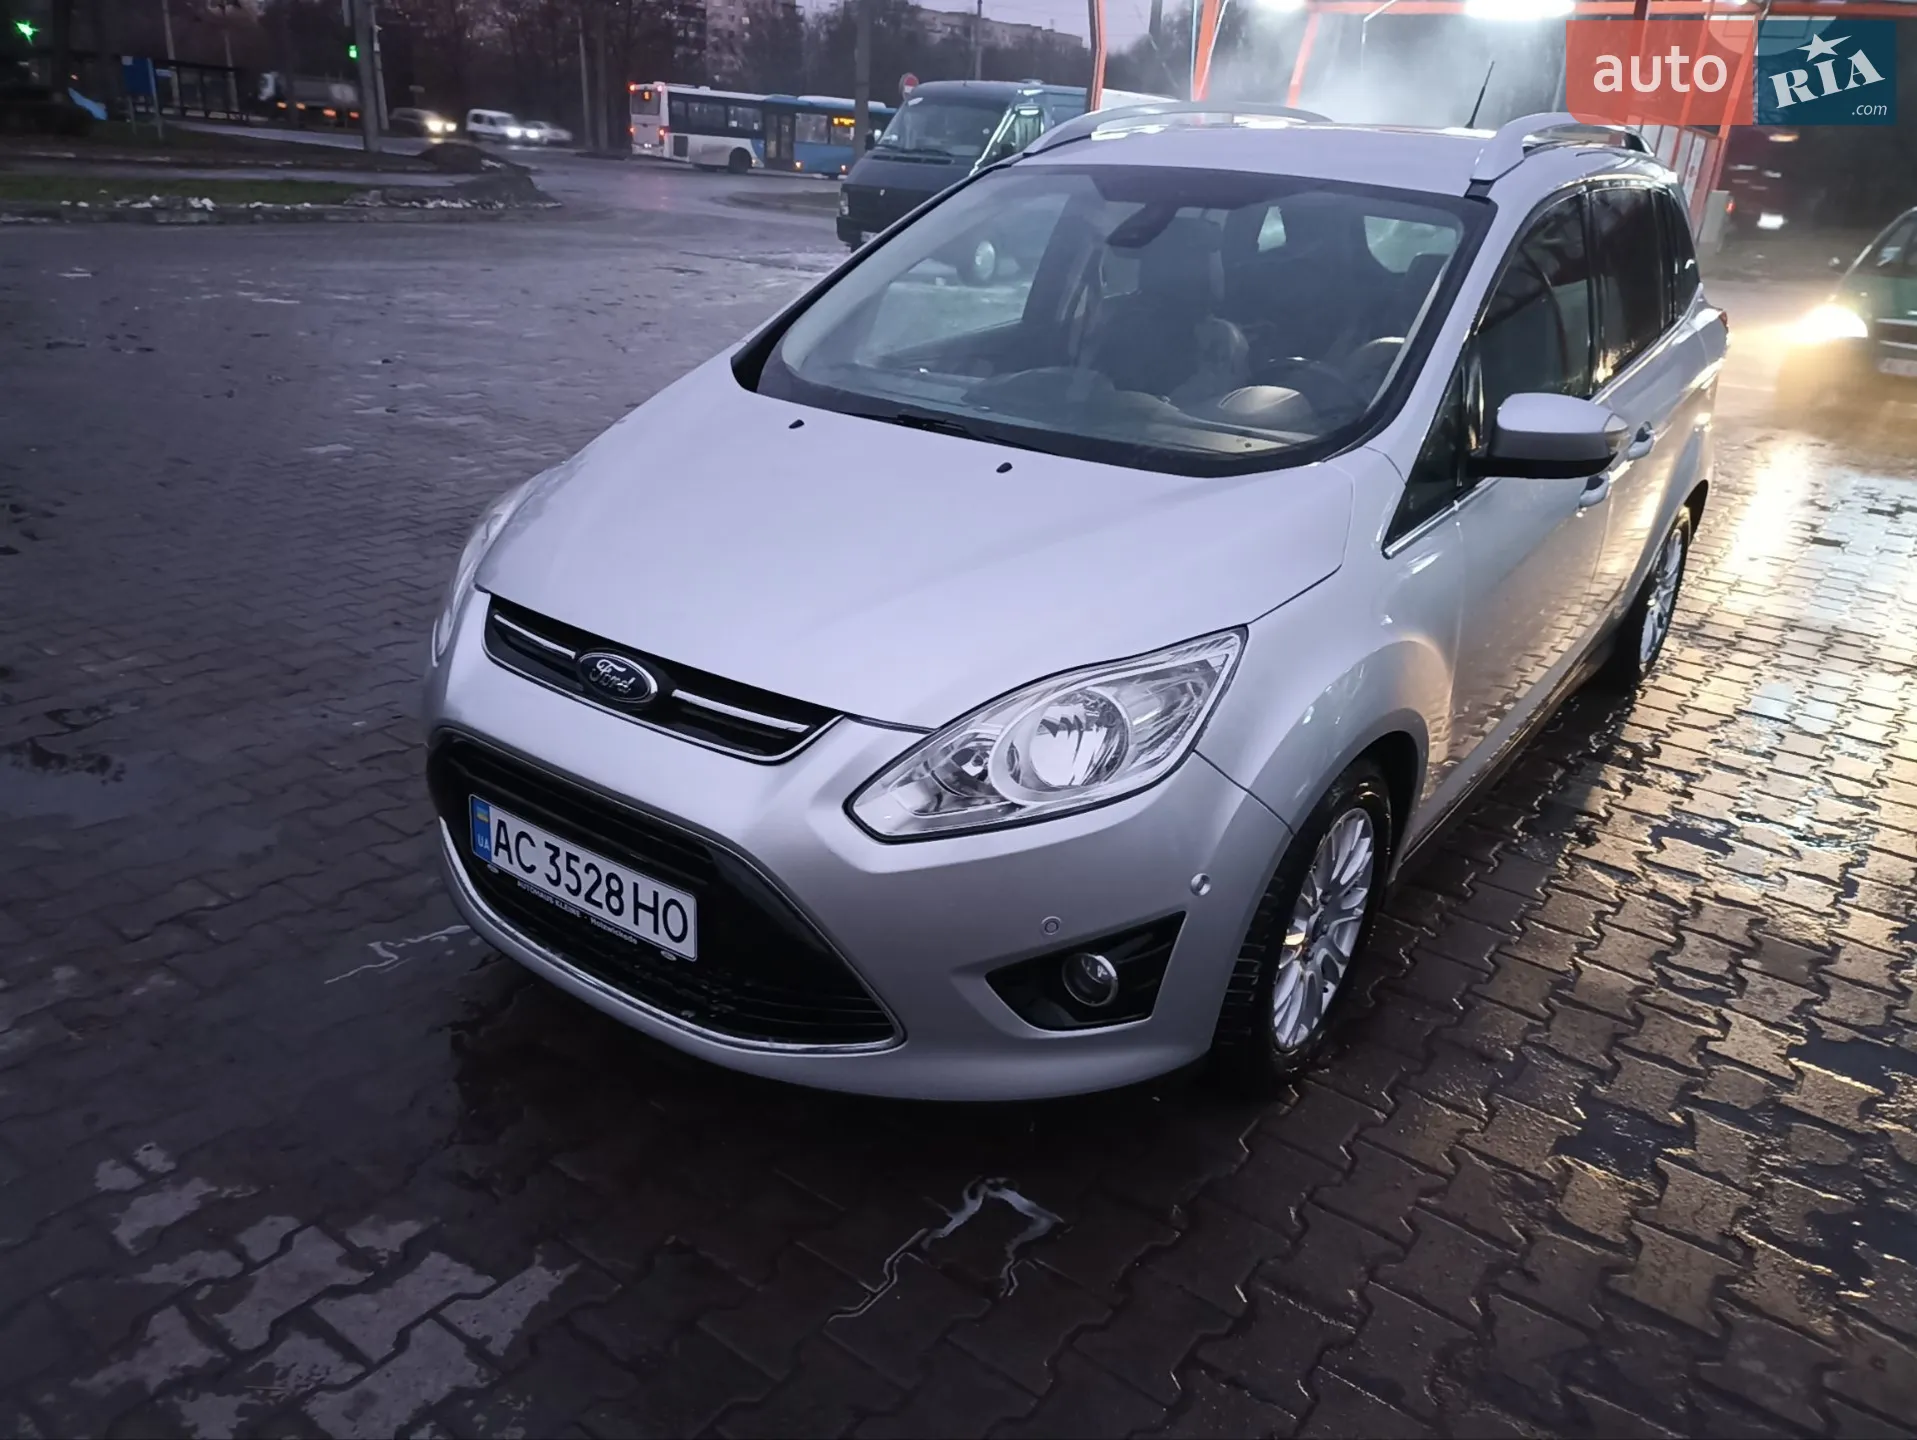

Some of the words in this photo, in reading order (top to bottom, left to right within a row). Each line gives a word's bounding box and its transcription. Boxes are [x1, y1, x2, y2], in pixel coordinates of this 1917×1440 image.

[589, 659, 636, 694] Ford
[477, 833, 491, 851] UA
[493, 818, 537, 874] AC
[544, 840, 625, 917] 3528
[632, 881, 688, 944] HO
